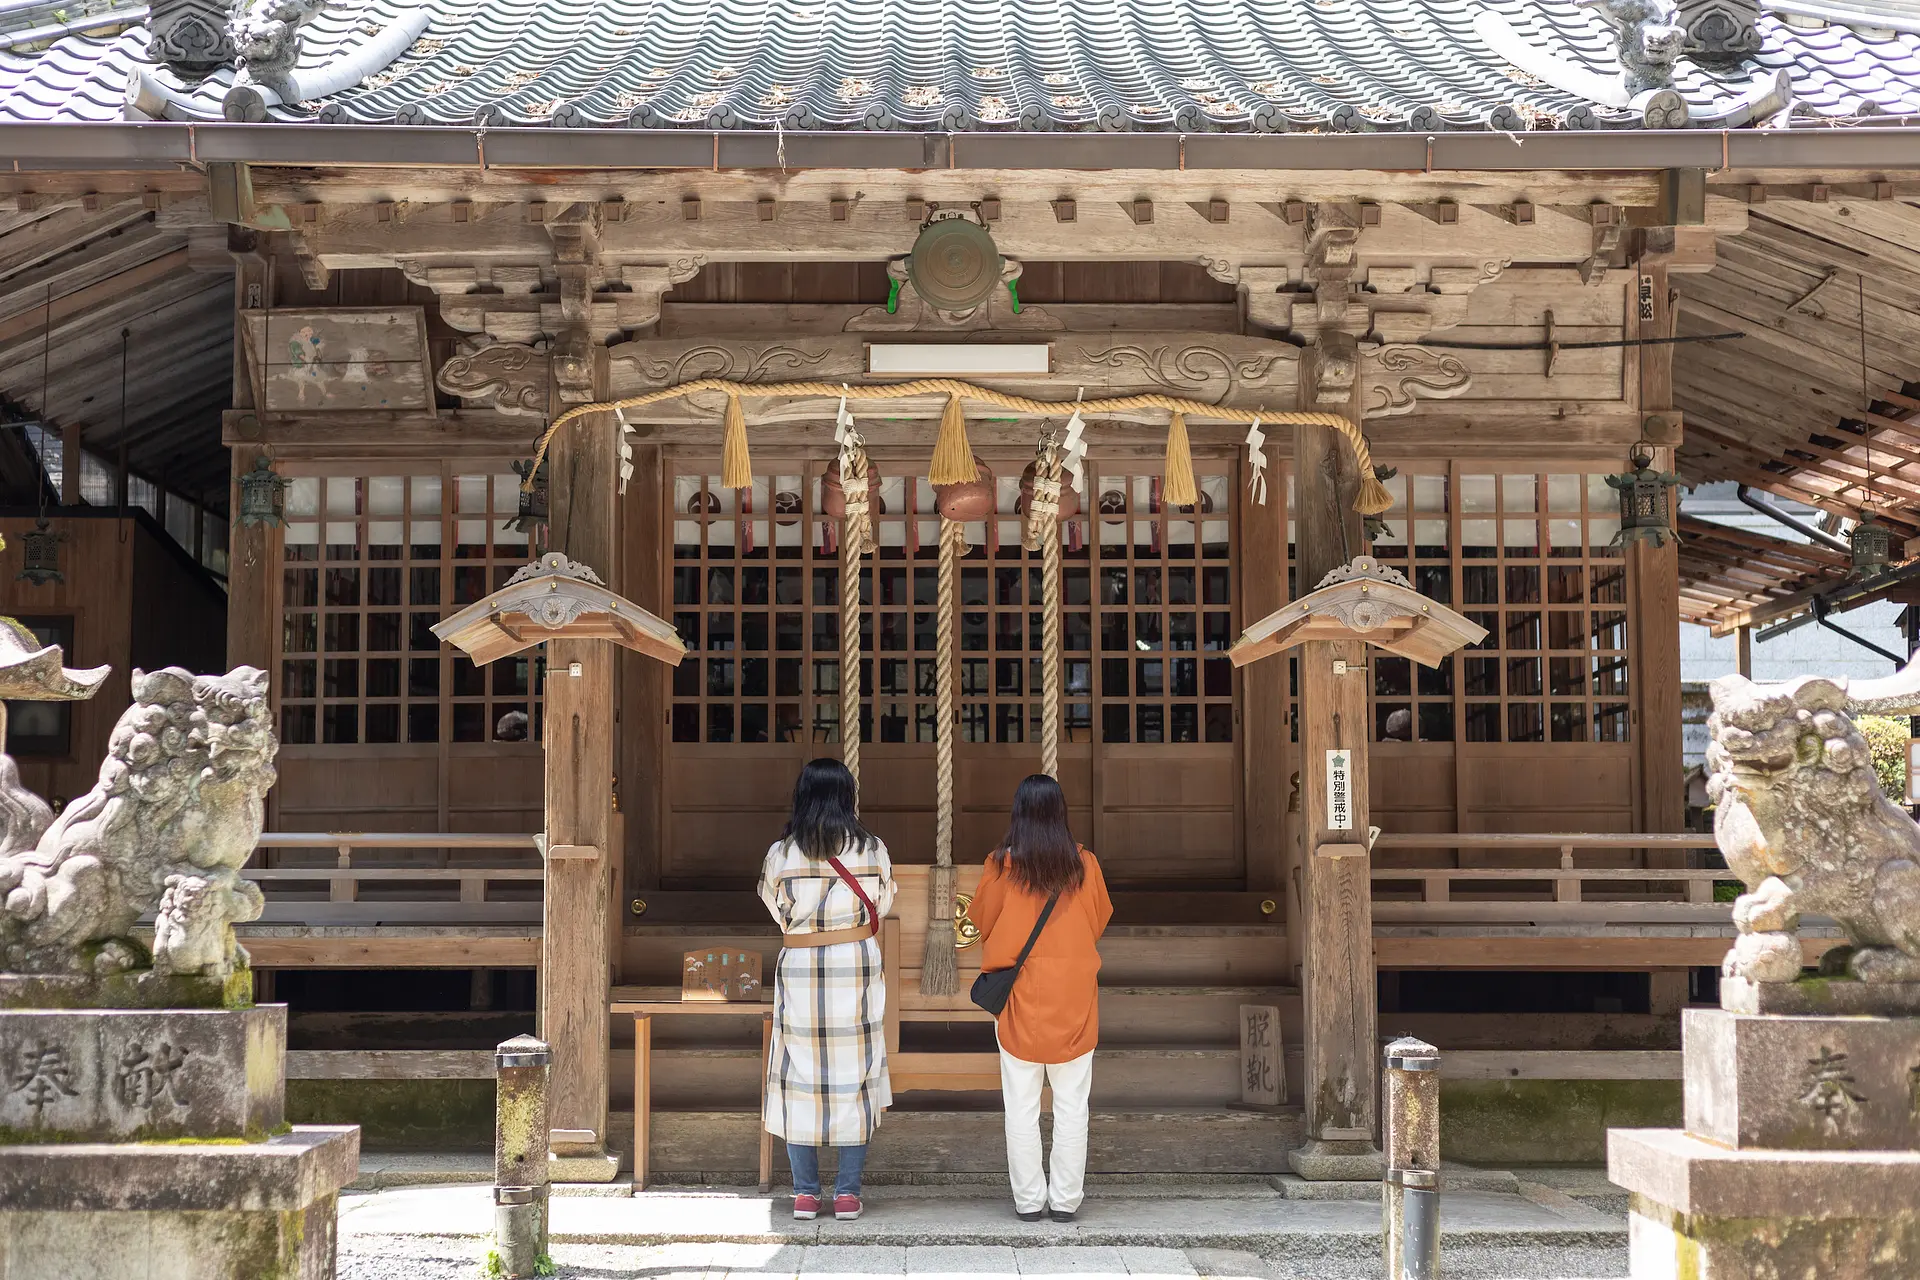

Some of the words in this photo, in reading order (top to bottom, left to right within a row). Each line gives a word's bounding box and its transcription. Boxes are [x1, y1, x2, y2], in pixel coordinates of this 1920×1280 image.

[1333, 769, 1346, 824] 特別警戒中
[13, 1040, 190, 1115] 奉献
[1246, 1010, 1274, 1093] 脱靴
[1797, 1045, 1920, 1122] 奉
